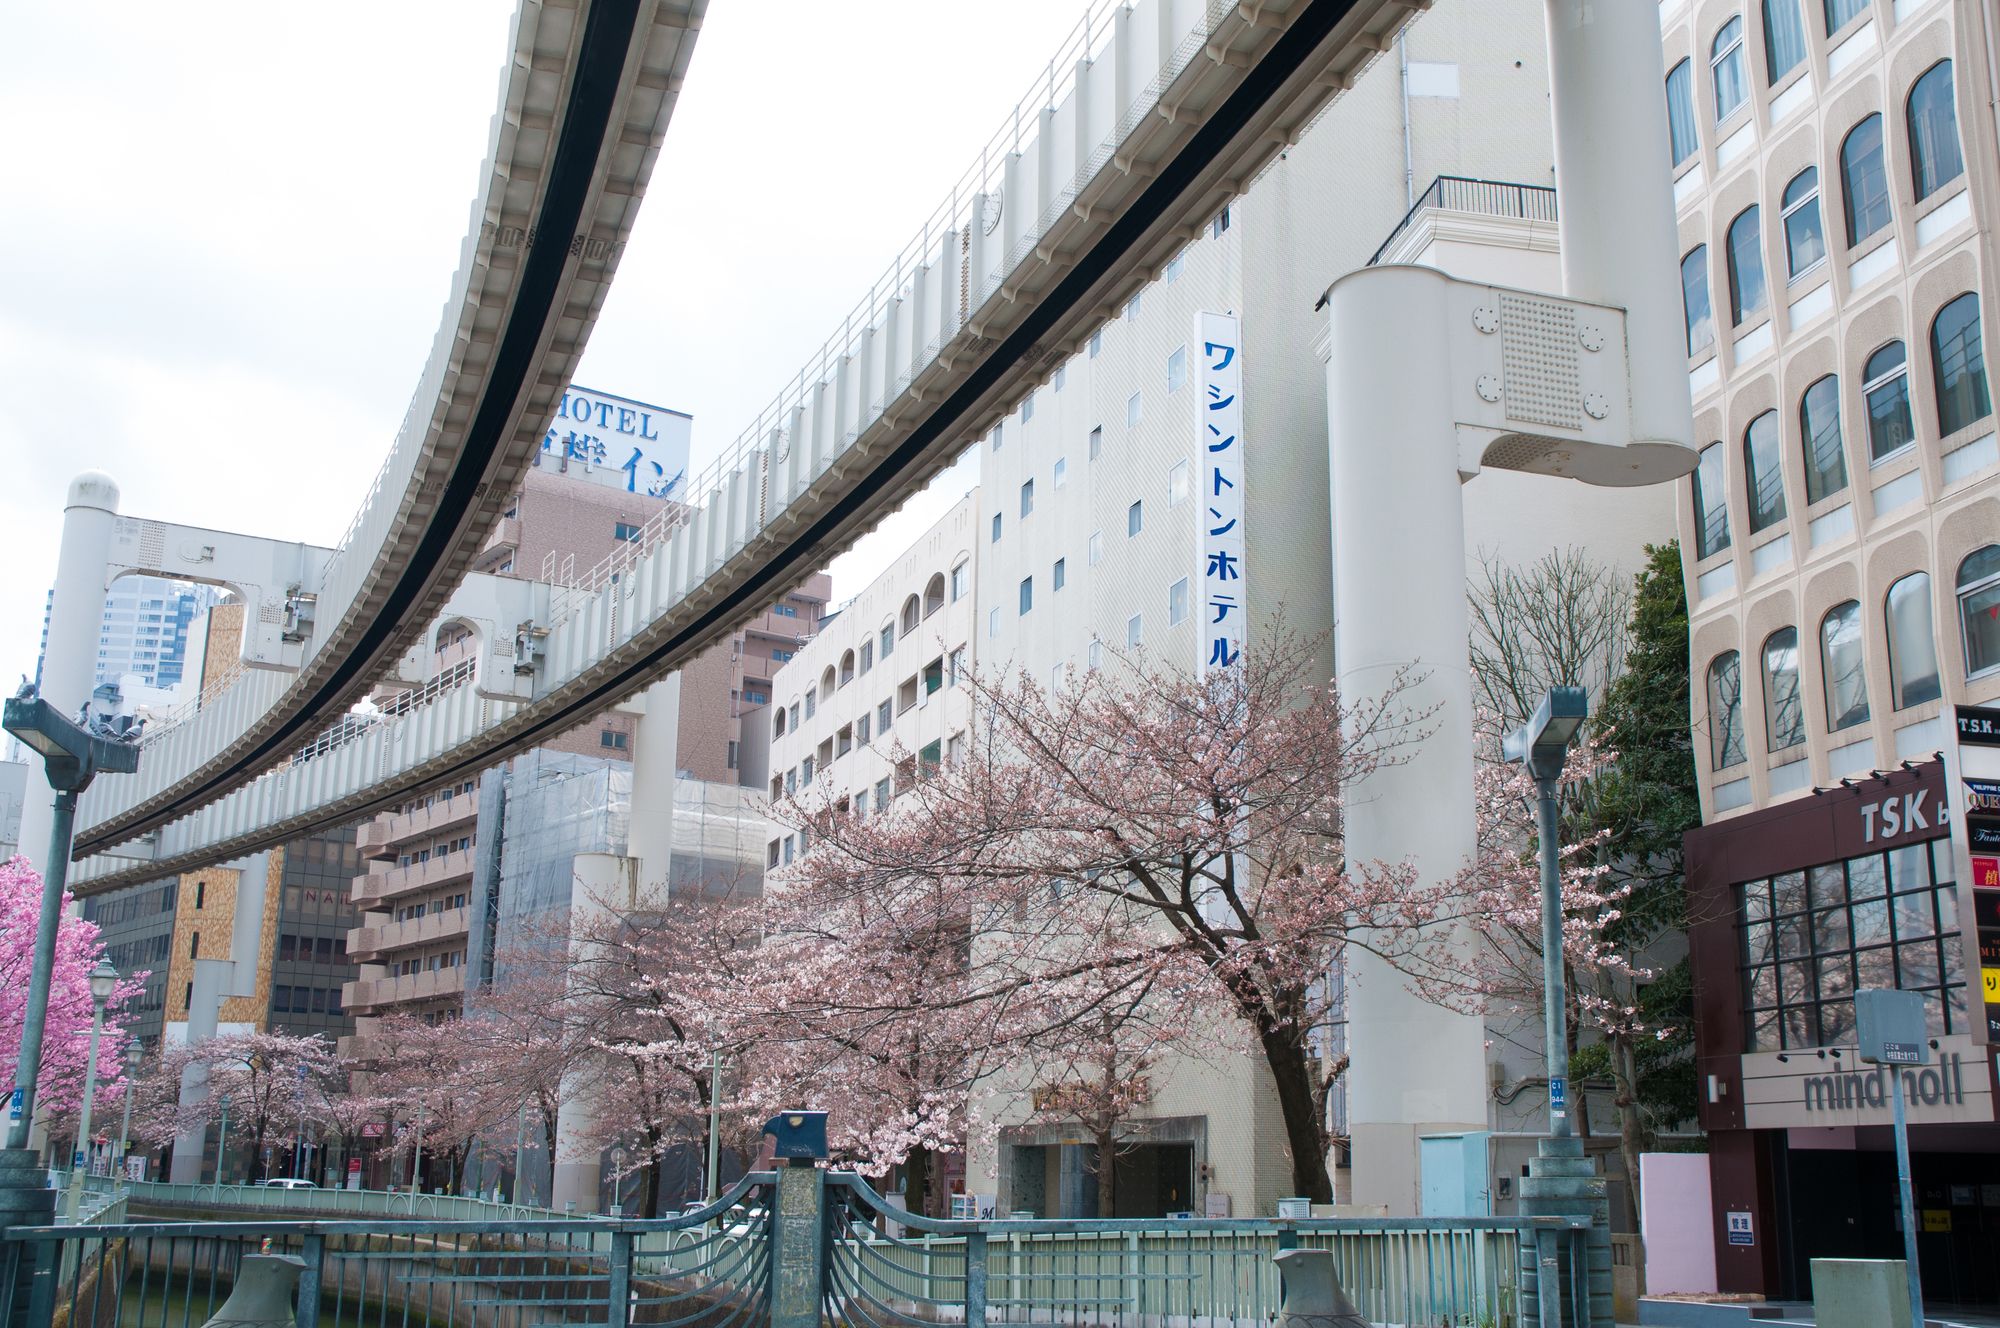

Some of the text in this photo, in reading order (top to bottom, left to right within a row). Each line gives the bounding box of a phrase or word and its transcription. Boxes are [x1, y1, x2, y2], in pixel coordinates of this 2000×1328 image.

[1204, 341, 1239, 668] ワシントンホテル
[1861, 788, 1929, 843] TSK
[306, 890, 353, 905] NAIL
[1551, 1095, 1564, 1103] 944
[1803, 1061, 1885, 1111] mind
